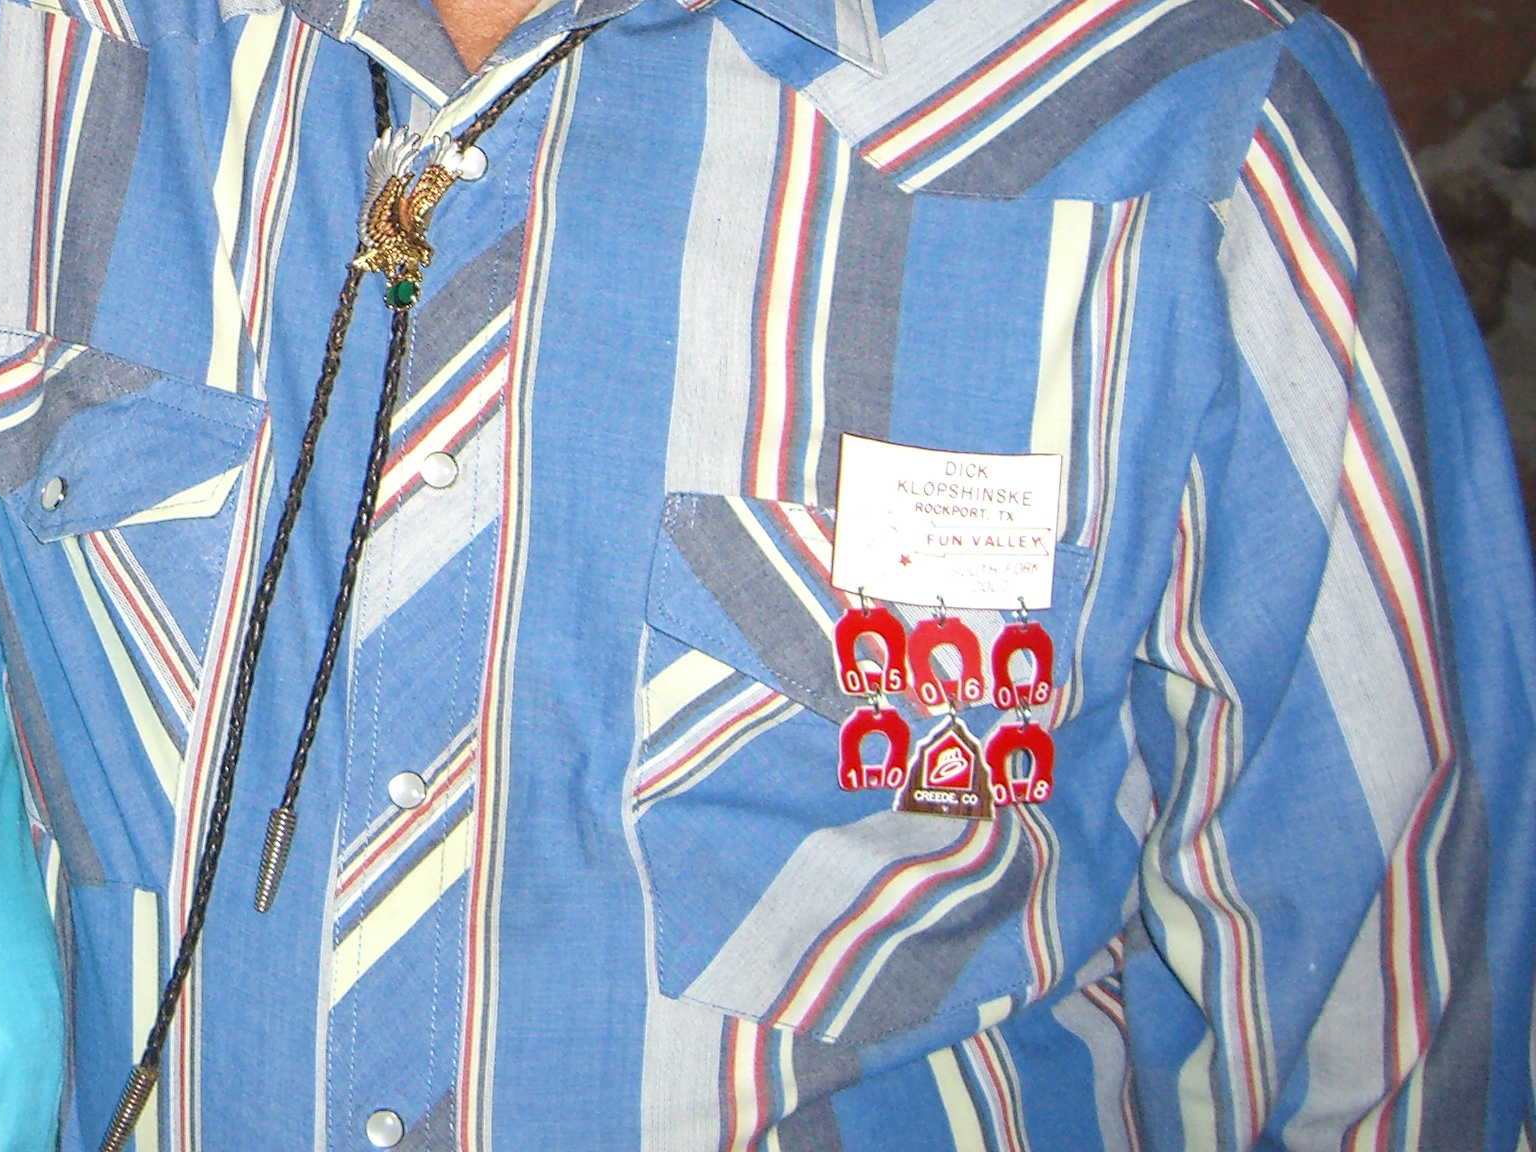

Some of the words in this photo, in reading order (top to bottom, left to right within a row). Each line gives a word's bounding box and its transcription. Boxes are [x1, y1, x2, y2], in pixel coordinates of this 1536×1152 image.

[945, 460, 989, 479] DICK
[897, 480, 1033, 507] KLOPSHINSKE
[999, 510, 1014, 522] TX
[926, 534, 963, 547] FUN
[972, 535, 1041, 548] VALLEY
[1005, 561, 1039, 575] FORK
[961, 791, 979, 805] CO
